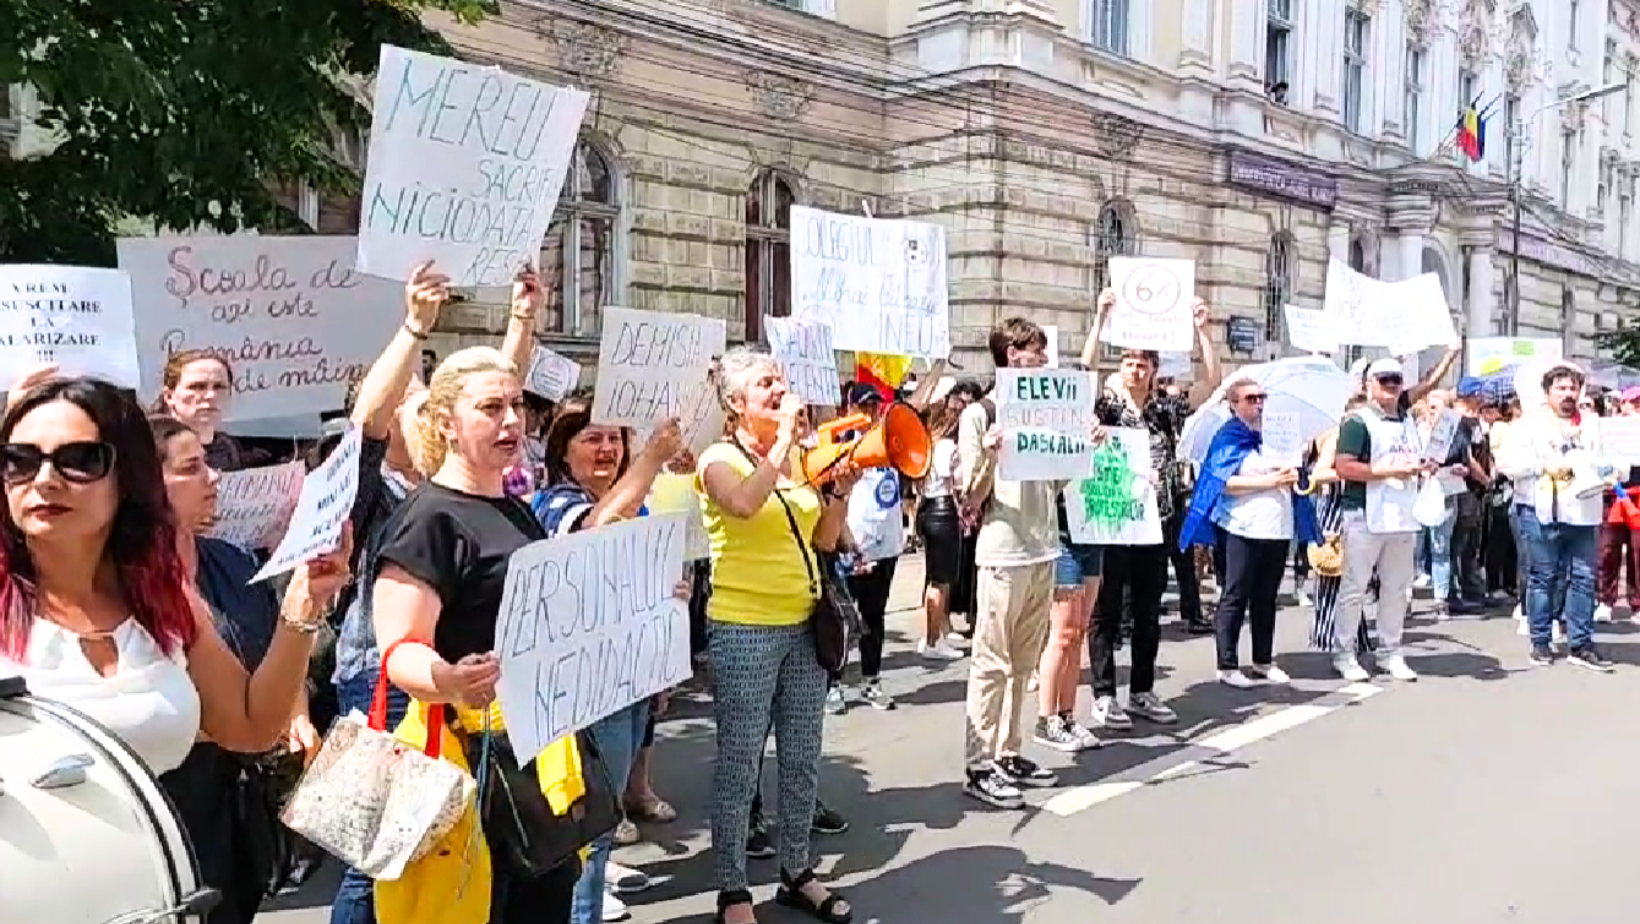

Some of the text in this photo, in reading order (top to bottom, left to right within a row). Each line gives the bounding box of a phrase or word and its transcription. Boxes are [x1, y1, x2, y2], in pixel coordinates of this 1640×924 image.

[386, 58, 558, 162] MEREU
[472, 158, 556, 202] SACRIF
[310, 259, 360, 289] de
[461, 247, 524, 286] RES
[161, 328, 324, 361] Rmânia
[234, 357, 364, 394] de mâin
[500, 522, 676, 658] PERSONALUL
[534, 607, 681, 747] NEDIDACTIC
